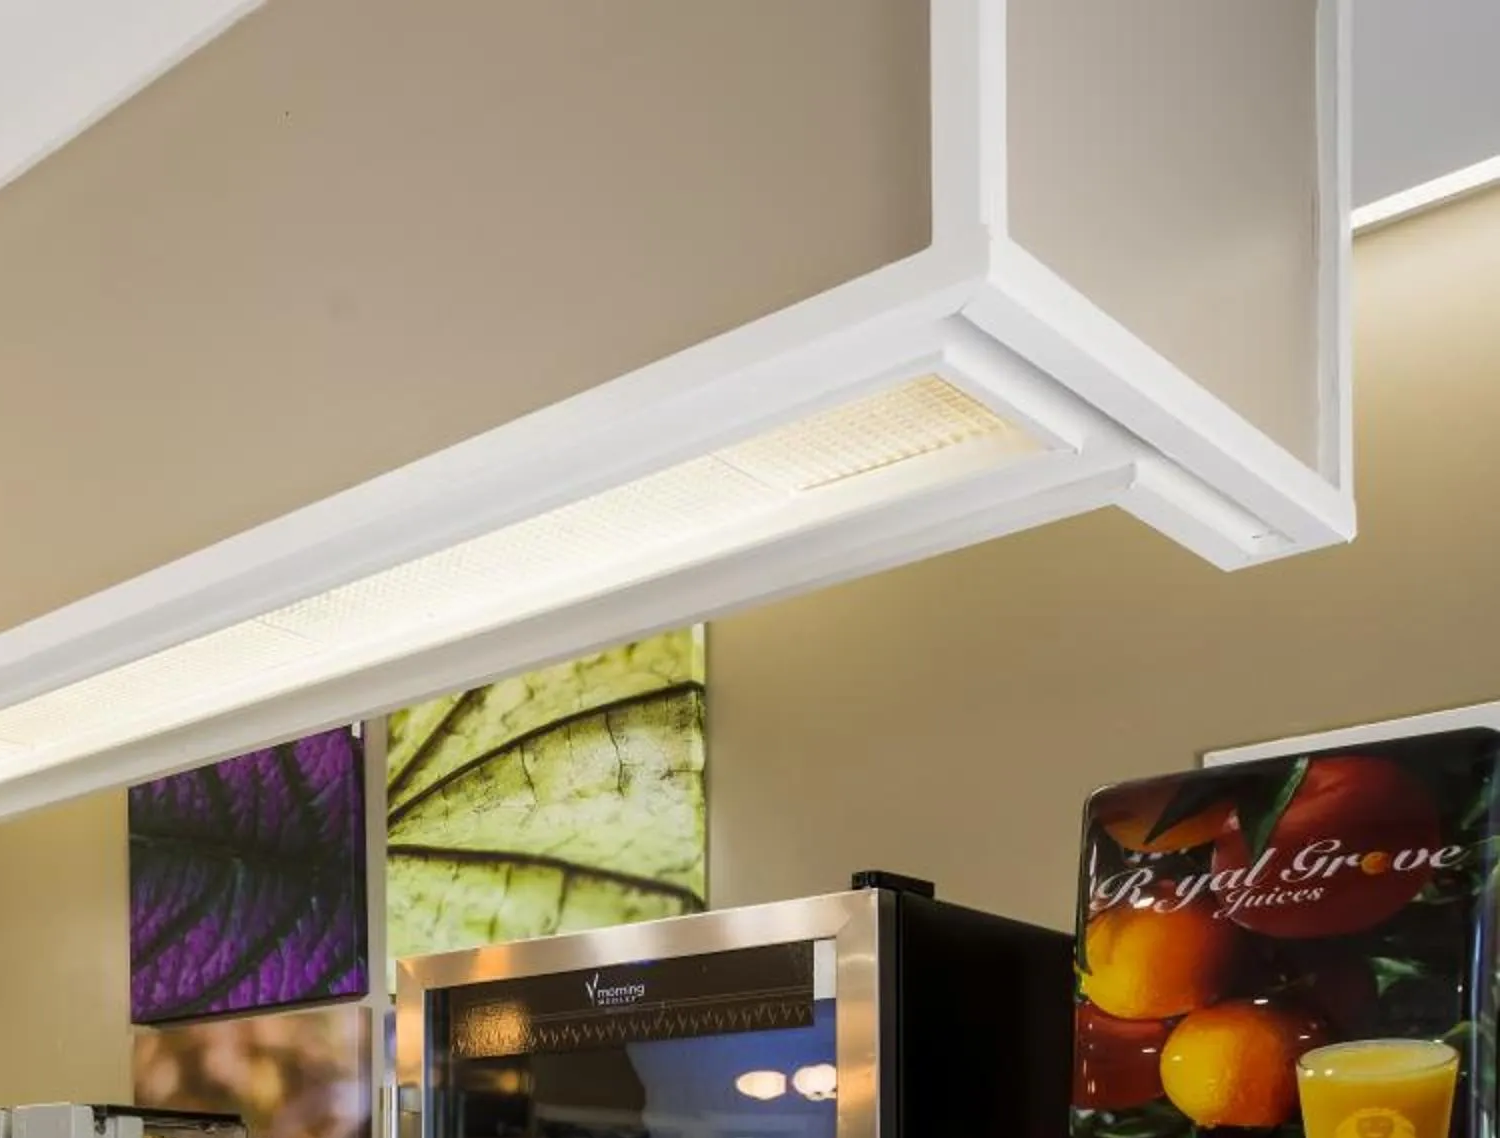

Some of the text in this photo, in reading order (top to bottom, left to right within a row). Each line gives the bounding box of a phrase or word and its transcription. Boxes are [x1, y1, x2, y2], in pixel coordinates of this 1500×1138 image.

[1280, 838, 1464, 880] Grove
[1212, 884, 1324, 920] Juices
[597, 984, 645, 997] morning
